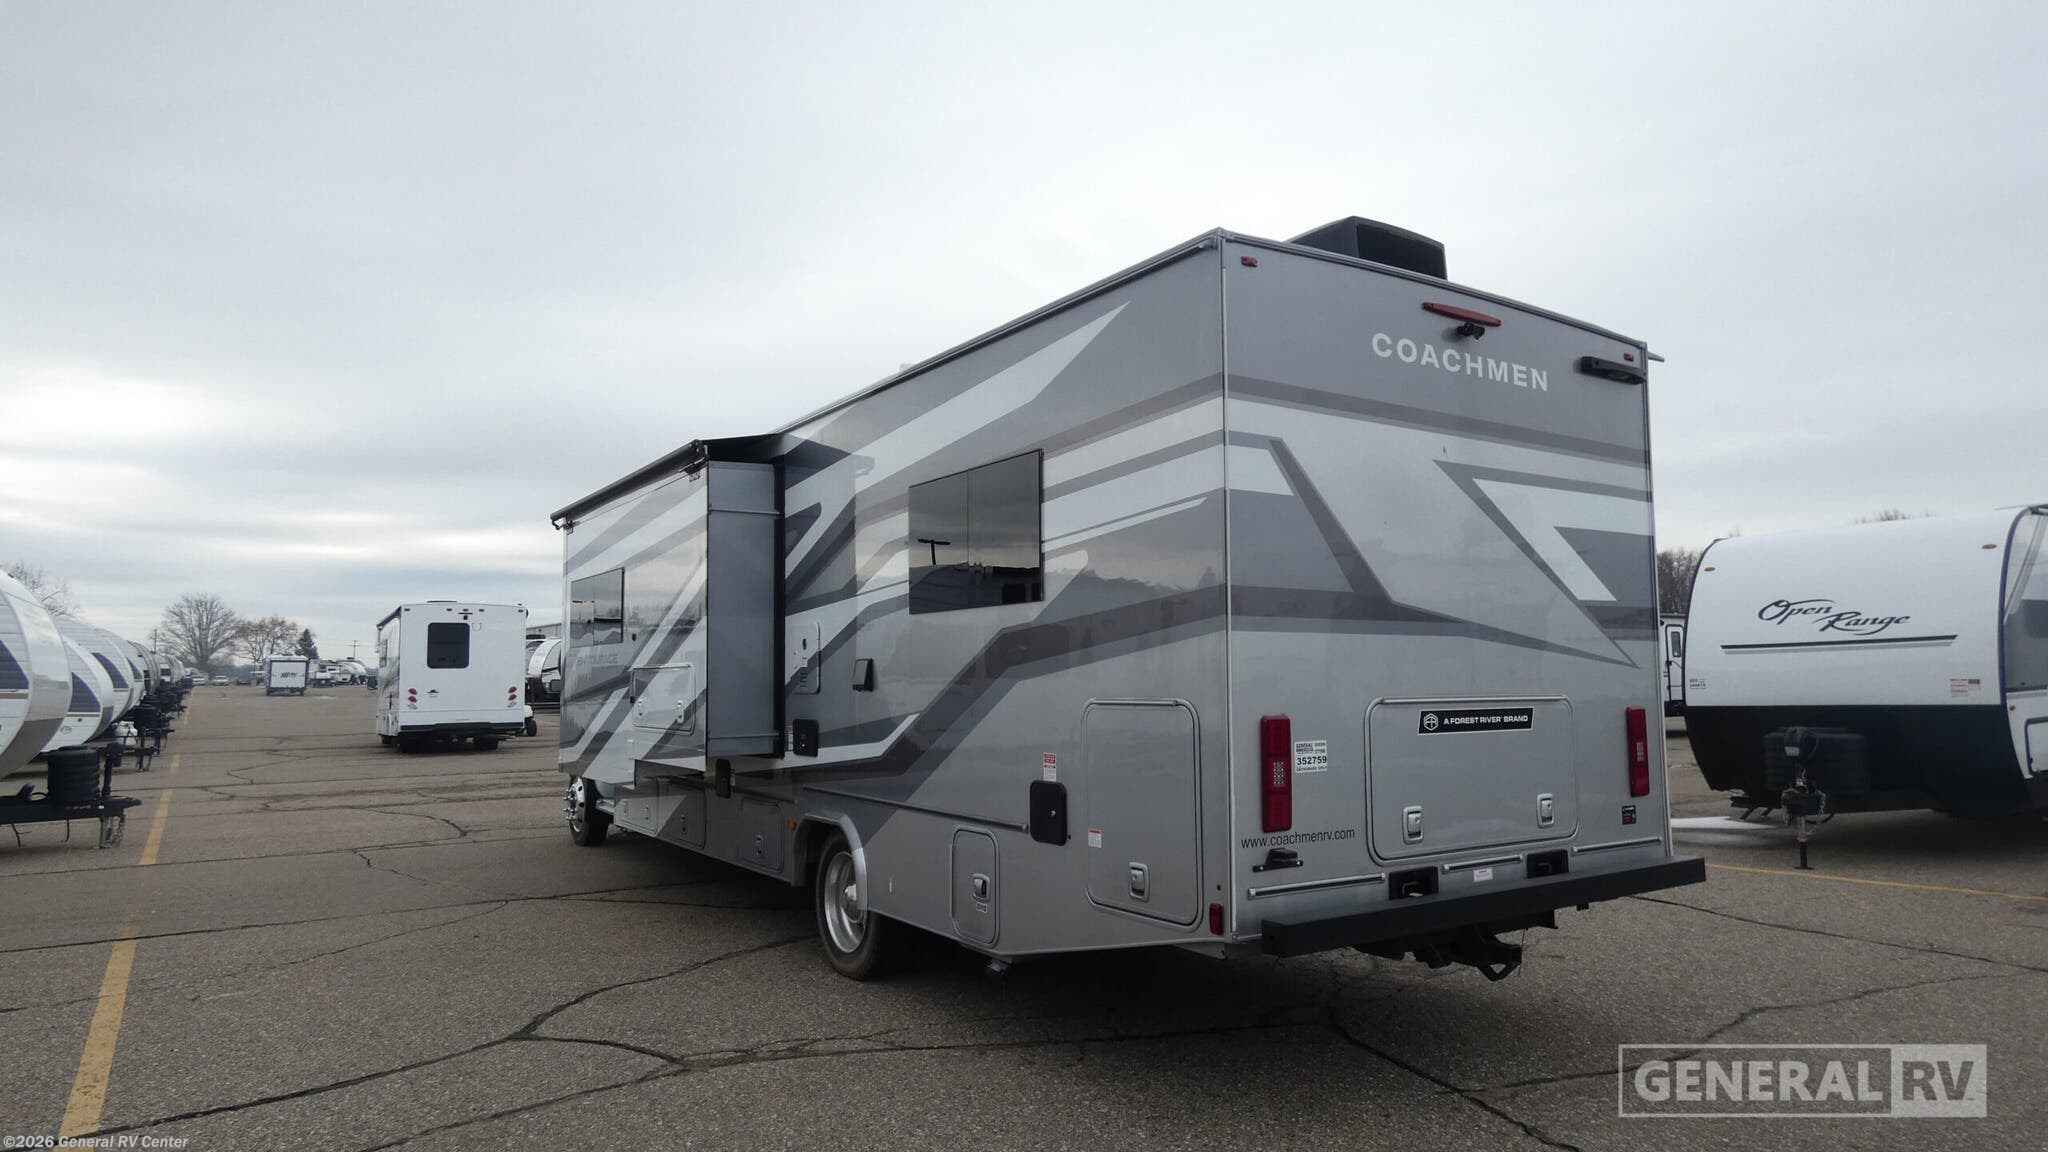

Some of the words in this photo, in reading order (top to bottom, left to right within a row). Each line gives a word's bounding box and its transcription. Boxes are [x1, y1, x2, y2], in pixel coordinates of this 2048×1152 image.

[1371, 333, 1548, 392] COACHMEN
[1758, 599, 1836, 625] Open
[1812, 611, 1911, 635] Range
[1443, 717, 1450, 725] A
[1450, 716, 1479, 725] FOREST
[1480, 715, 1501, 724] RIVER
[1503, 715, 1529, 723] BRAND
[1296, 755, 1328, 766] 352759
[1241, 829, 1355, 849] www.coachmenrv.com
